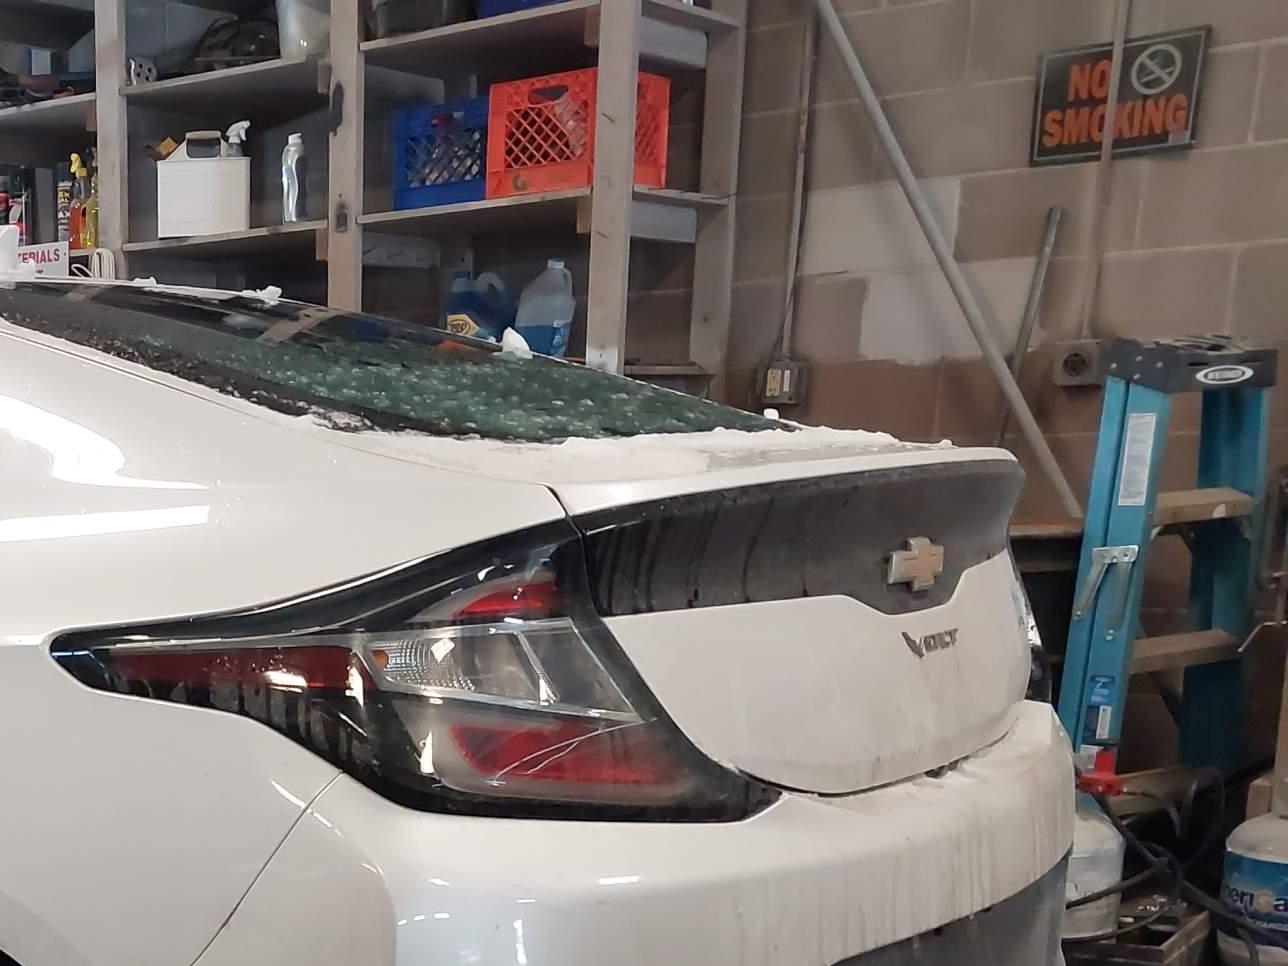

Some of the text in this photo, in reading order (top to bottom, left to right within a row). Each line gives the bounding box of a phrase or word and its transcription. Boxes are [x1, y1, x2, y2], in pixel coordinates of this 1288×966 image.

[1067, 60, 1112, 102] NO
[1042, 94, 1188, 147] SMOKING
[901, 628, 959, 658] VOLT
